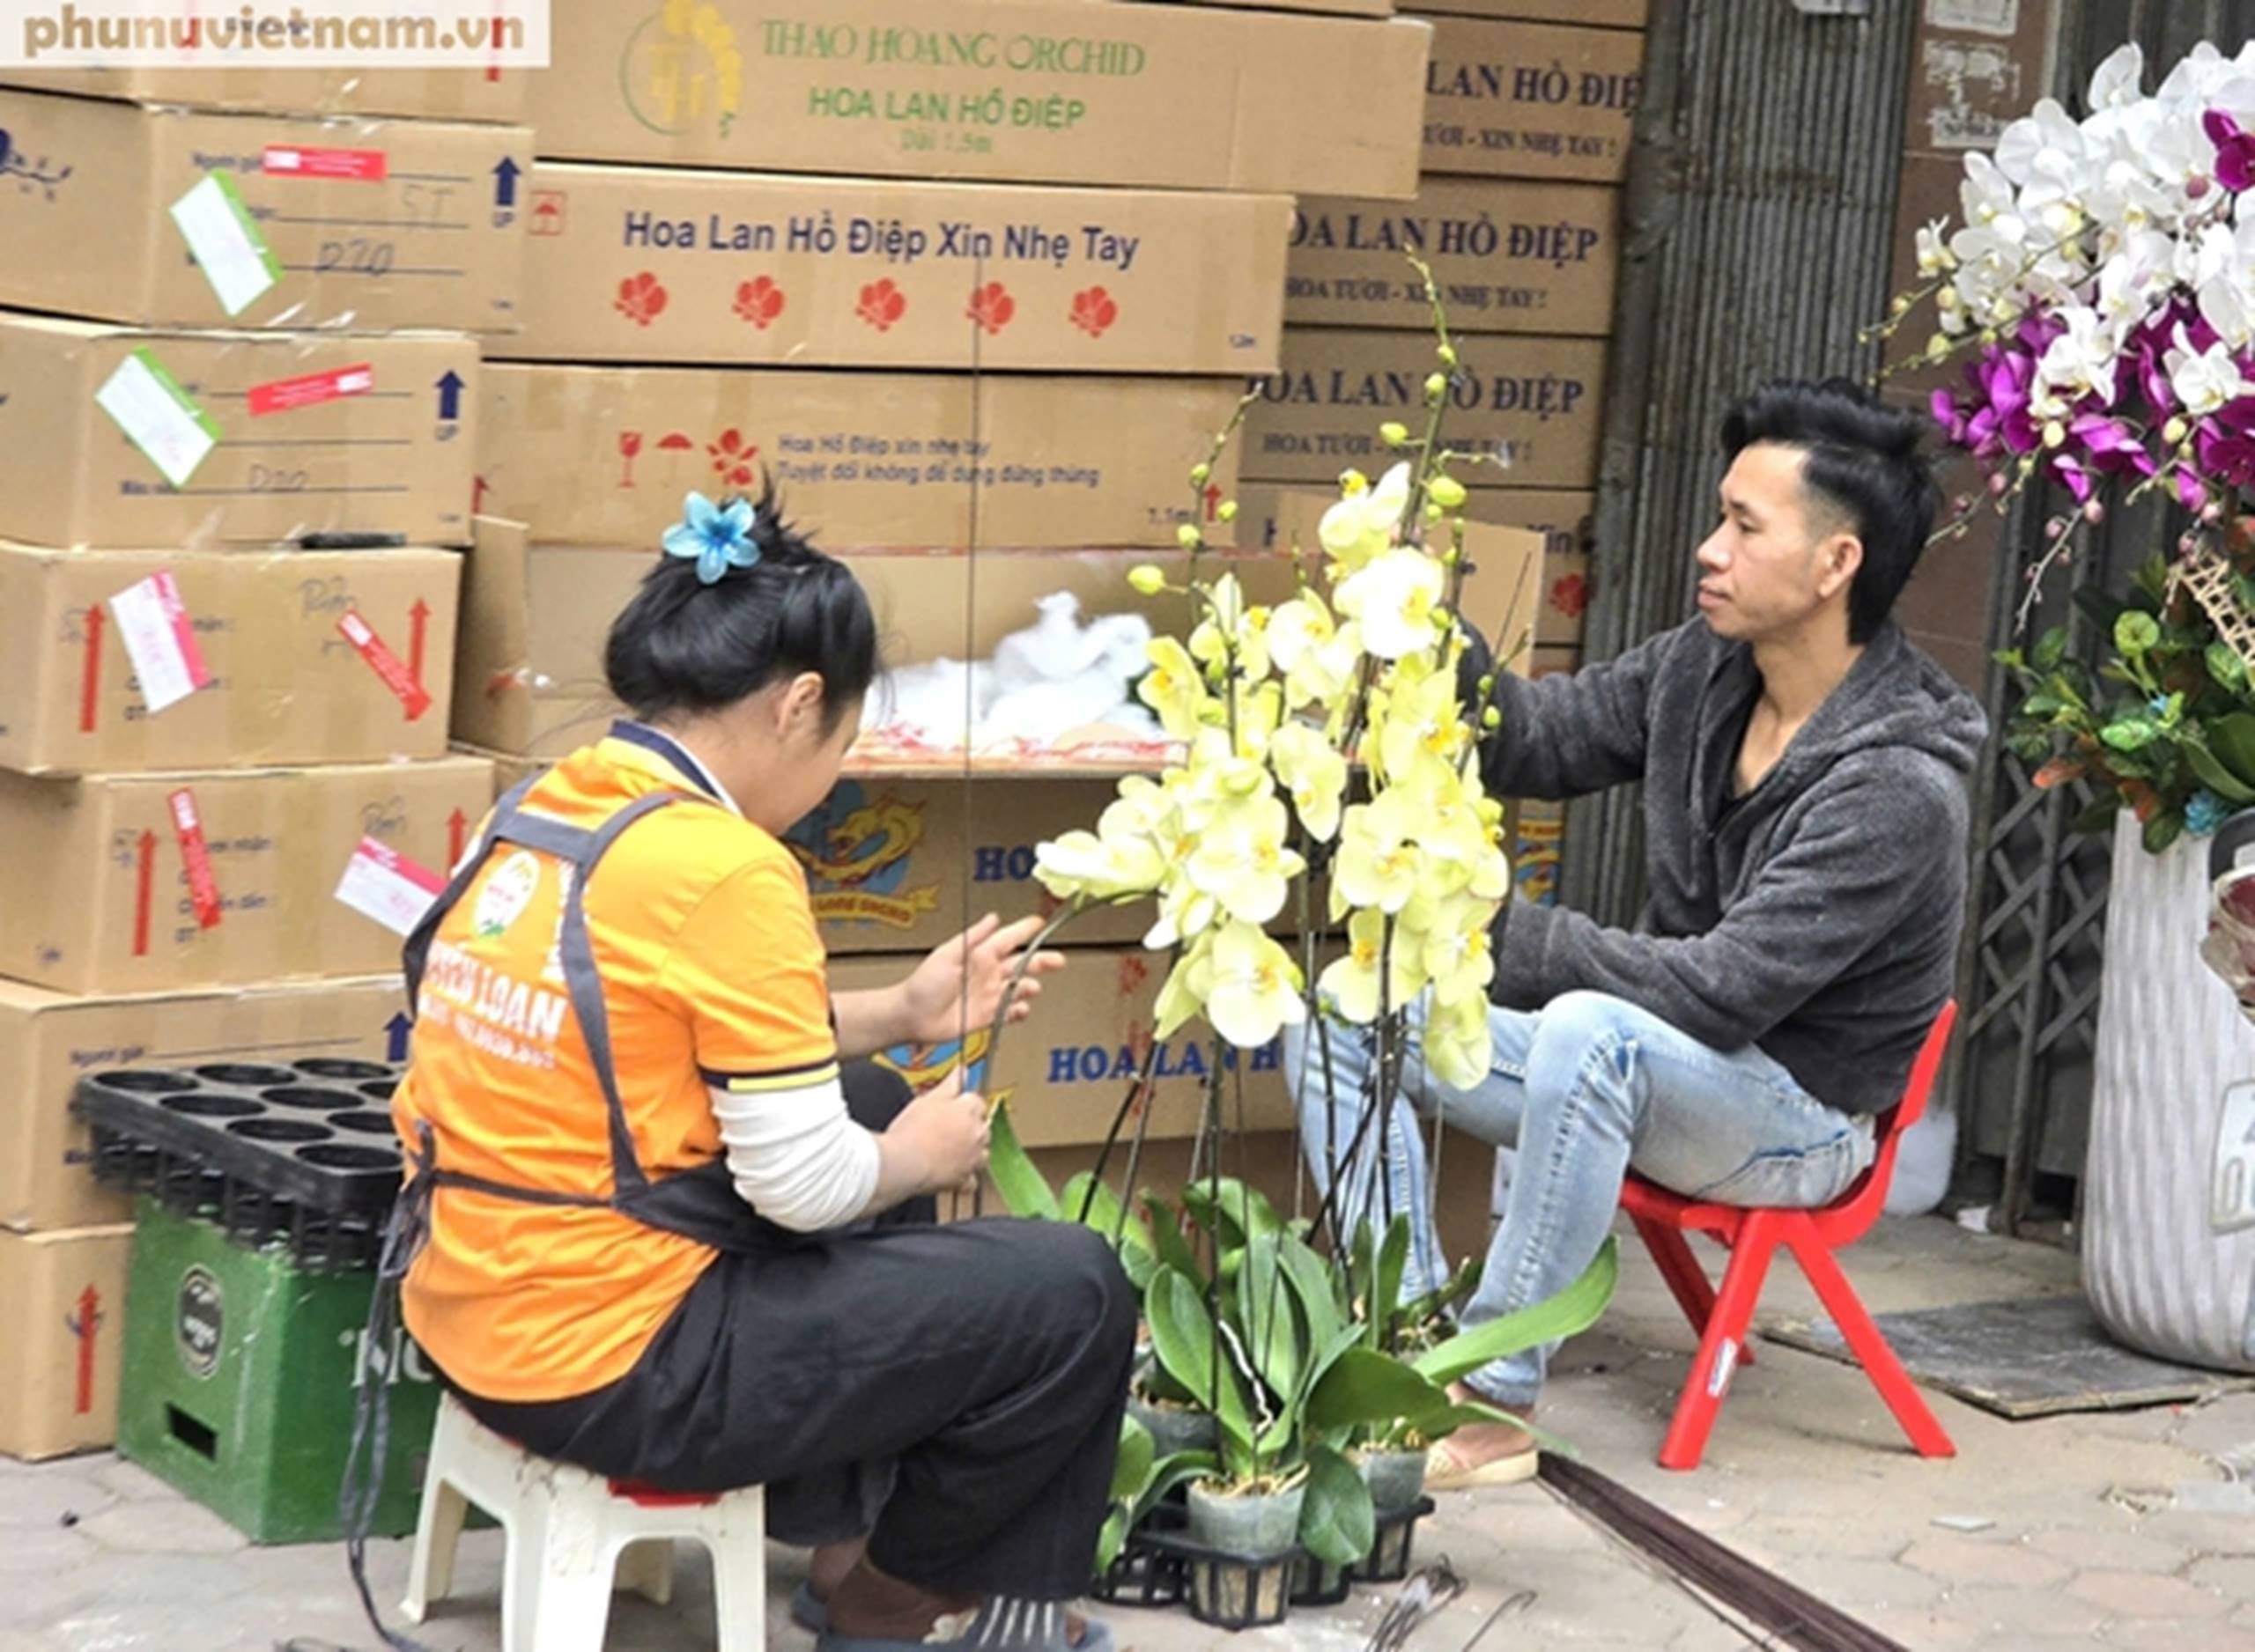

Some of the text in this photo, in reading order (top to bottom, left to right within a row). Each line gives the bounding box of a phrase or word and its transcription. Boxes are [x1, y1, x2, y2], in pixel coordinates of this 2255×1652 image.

[1005, 34, 1145, 77] ORCHID
[808, 86, 876, 118] HOA
[885, 91, 949, 123] LAN
[1425, 60, 1503, 98] LAN
[1578, 70, 1642, 118] ĐIỆ
[624, 211, 697, 247] Hoa
[709, 214, 776, 250] Lan
[848, 218, 927, 263] Điệp
[936, 222, 993, 258] Xin
[1003, 225, 1069, 268] Nhẹ
[1081, 225, 1139, 271] Tay
[1289, 213, 1336, 247] OA
[1345, 214, 1427, 252] LAN
[1508, 219, 1599, 268] ĐIỆP
[1328, 371, 1413, 407] LAN
[1493, 372, 1583, 420] ĐIỆP
[778, 434, 814, 454] Hoa
[973, 845, 1035, 881] HO
[474, 966, 568, 1043] LOAN
[1048, 1045, 1135, 1083] HOA
